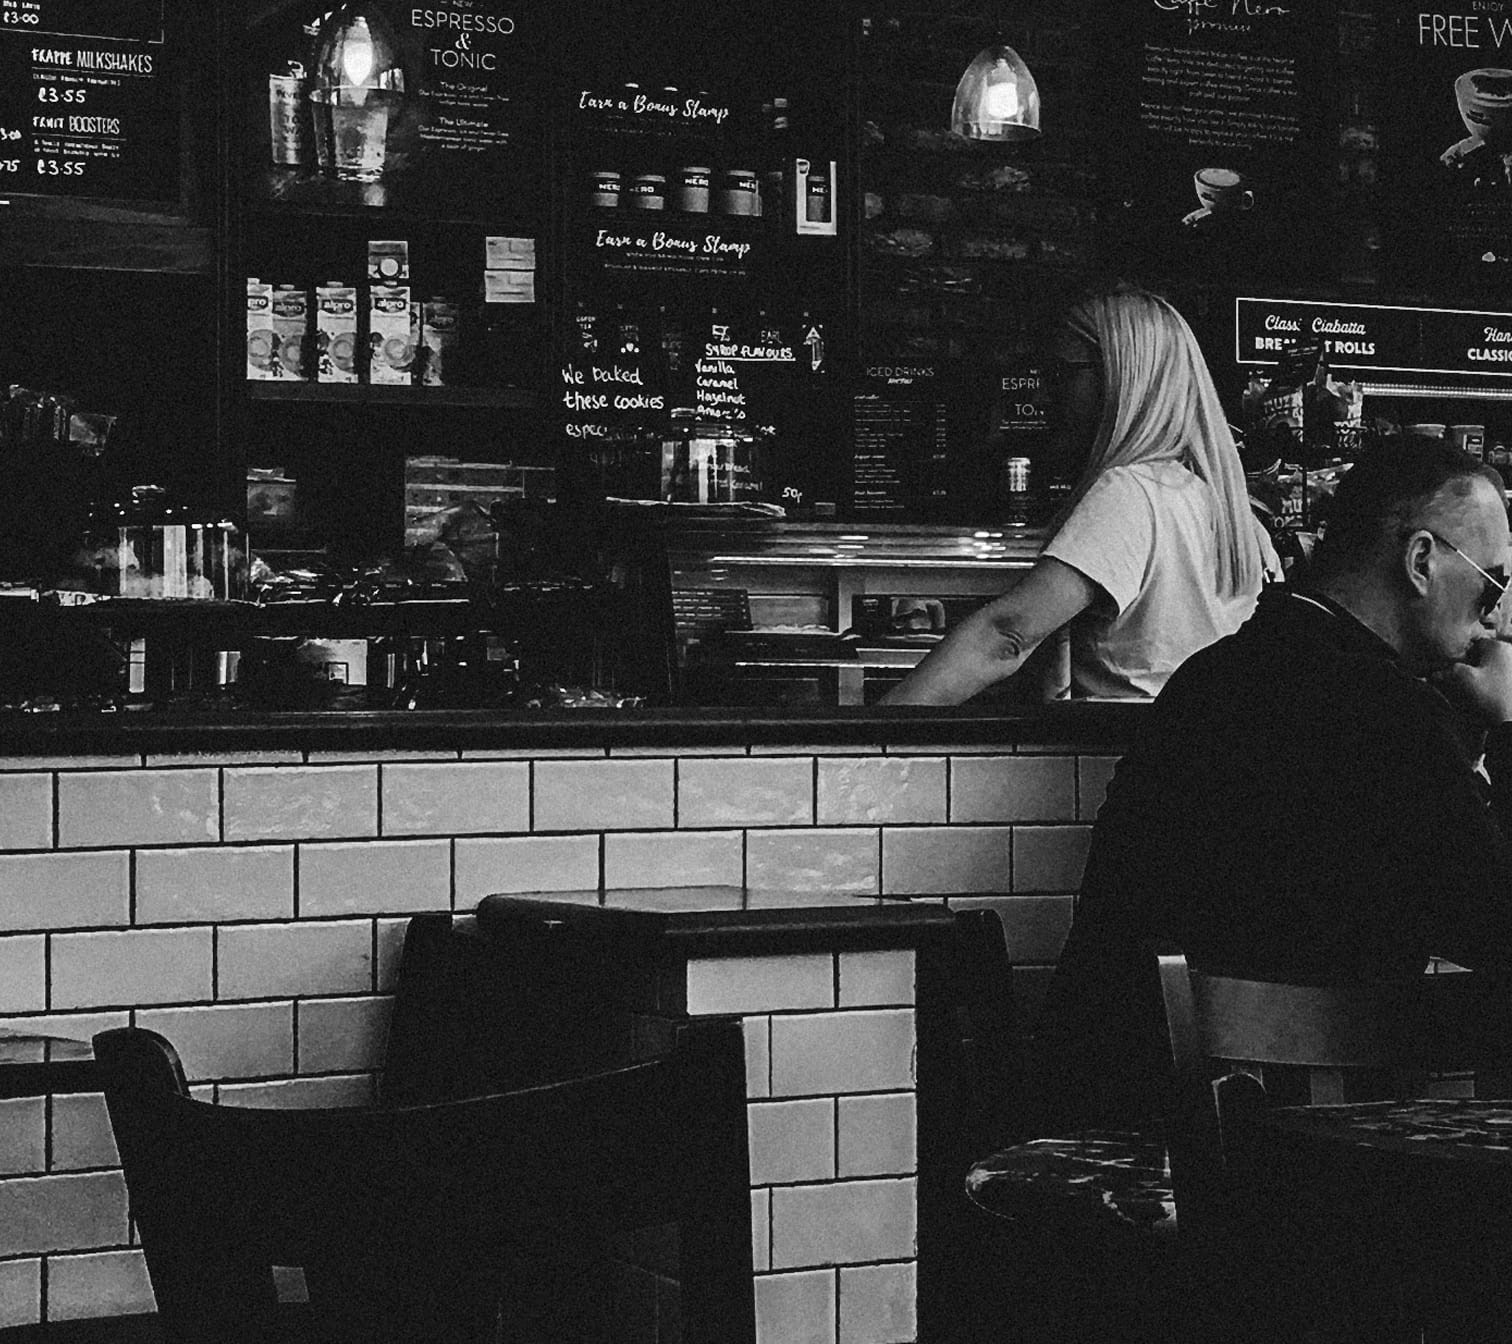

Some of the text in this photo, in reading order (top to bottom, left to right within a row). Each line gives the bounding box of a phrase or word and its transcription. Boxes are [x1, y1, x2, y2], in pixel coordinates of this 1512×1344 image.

[1472, 0, 1504, 12] ENJOY
[411, 8, 516, 35] ESPRESSO
[1418, 12, 1480, 49] FREE
[455, 32, 472, 50] &
[76, 49, 153, 73] MILKSHAKES
[430, 48, 497, 71] TONIC
[618, 100, 630, 111] a
[633, 94, 679, 117] Bonus
[682, 98, 729, 125] Stamp
[69, 115, 120, 135] BOOSTERS
[636, 237, 648, 248] a
[652, 231, 698, 253] Bonus
[703, 235, 751, 260] Stamp
[376, 298, 405, 311] alpro
[1312, 317, 1367, 336] Ciabatta
[1334, 341, 1377, 355] ROLLS
[561, 362, 644, 386] We baked
[694, 357, 736, 375] Vanilla
[696, 375, 739, 390] Caramel
[1001, 376, 1041, 390] ESPR
[562, 390, 665, 411] these cookies
